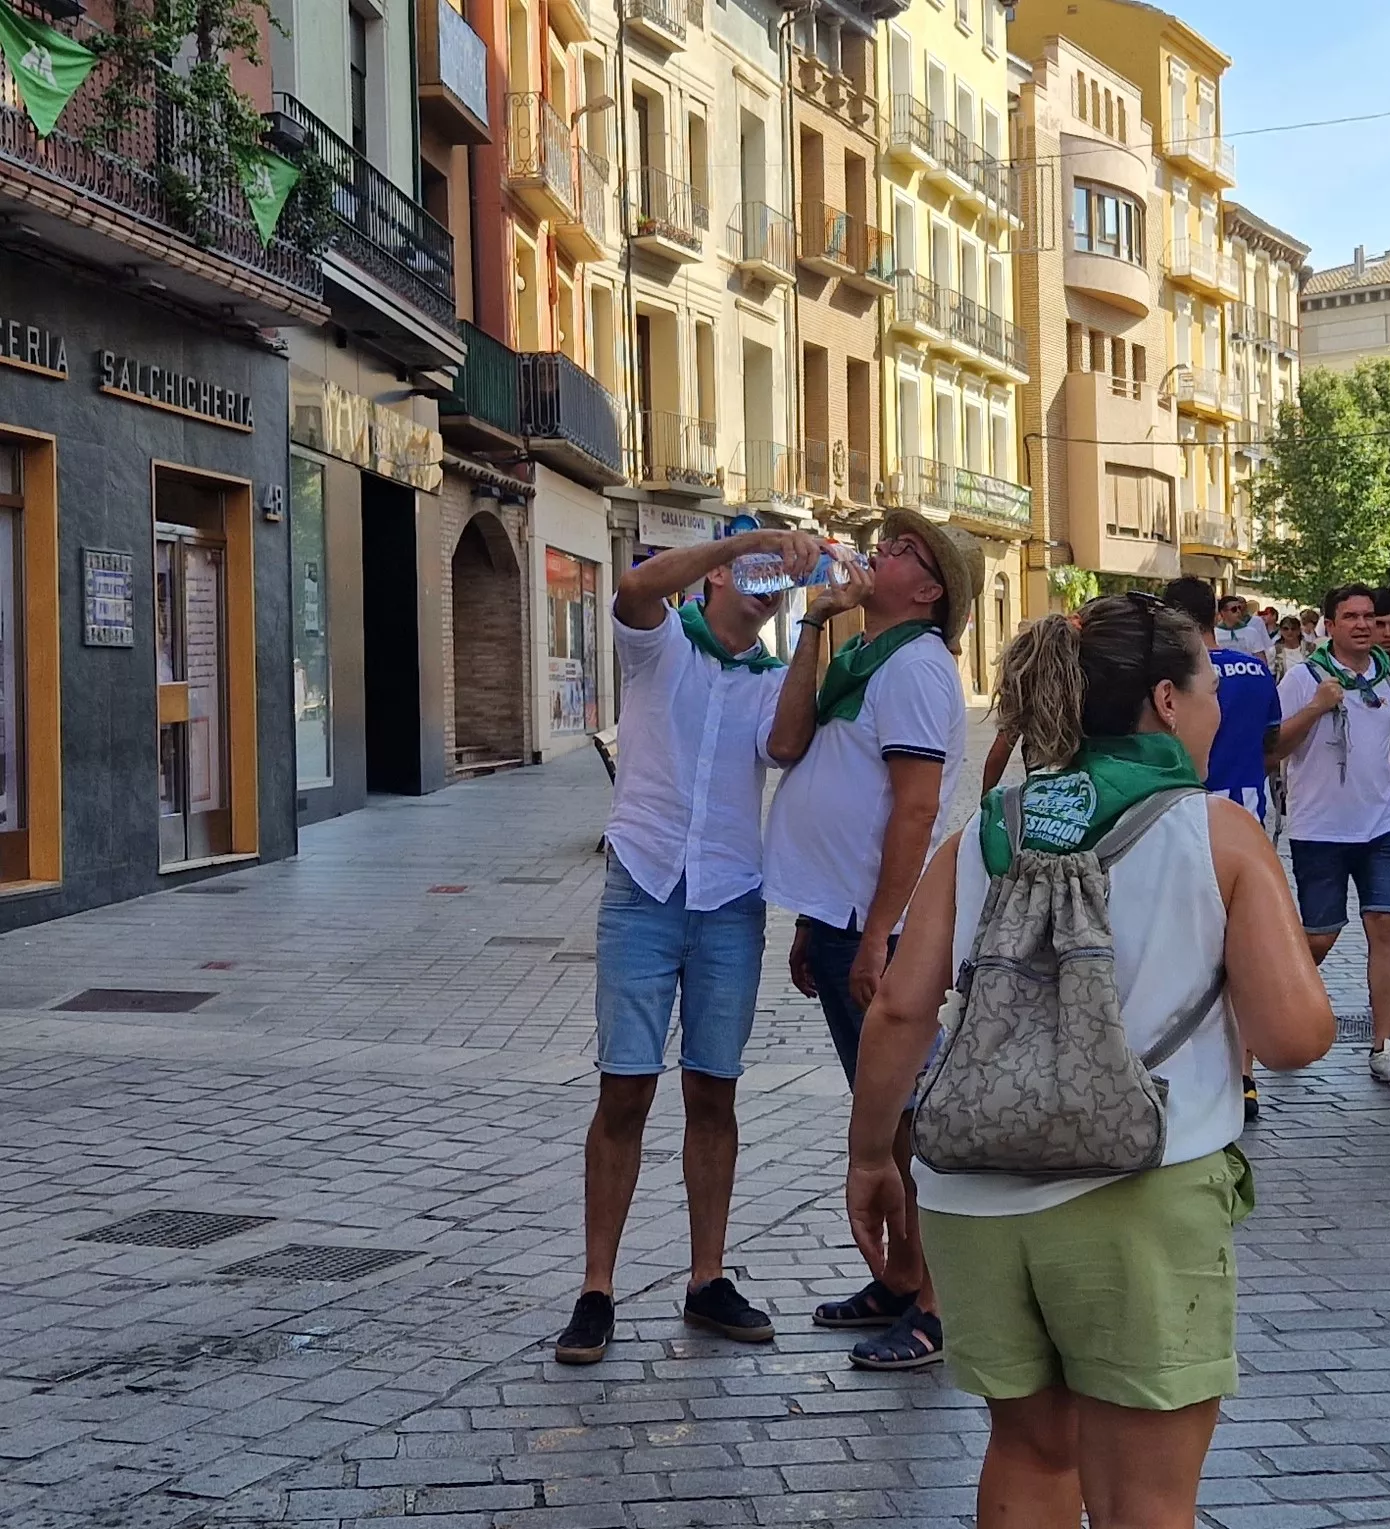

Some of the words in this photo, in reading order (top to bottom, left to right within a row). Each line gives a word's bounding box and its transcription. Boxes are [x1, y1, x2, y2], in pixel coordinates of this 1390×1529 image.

[0, 317, 69, 374] ERIA
[102, 350, 256, 428] SALCHICHERIA
[263, 483, 284, 516] 48
[661, 511, 678, 526] CASA
[1224, 661, 1266, 677] BOCK
